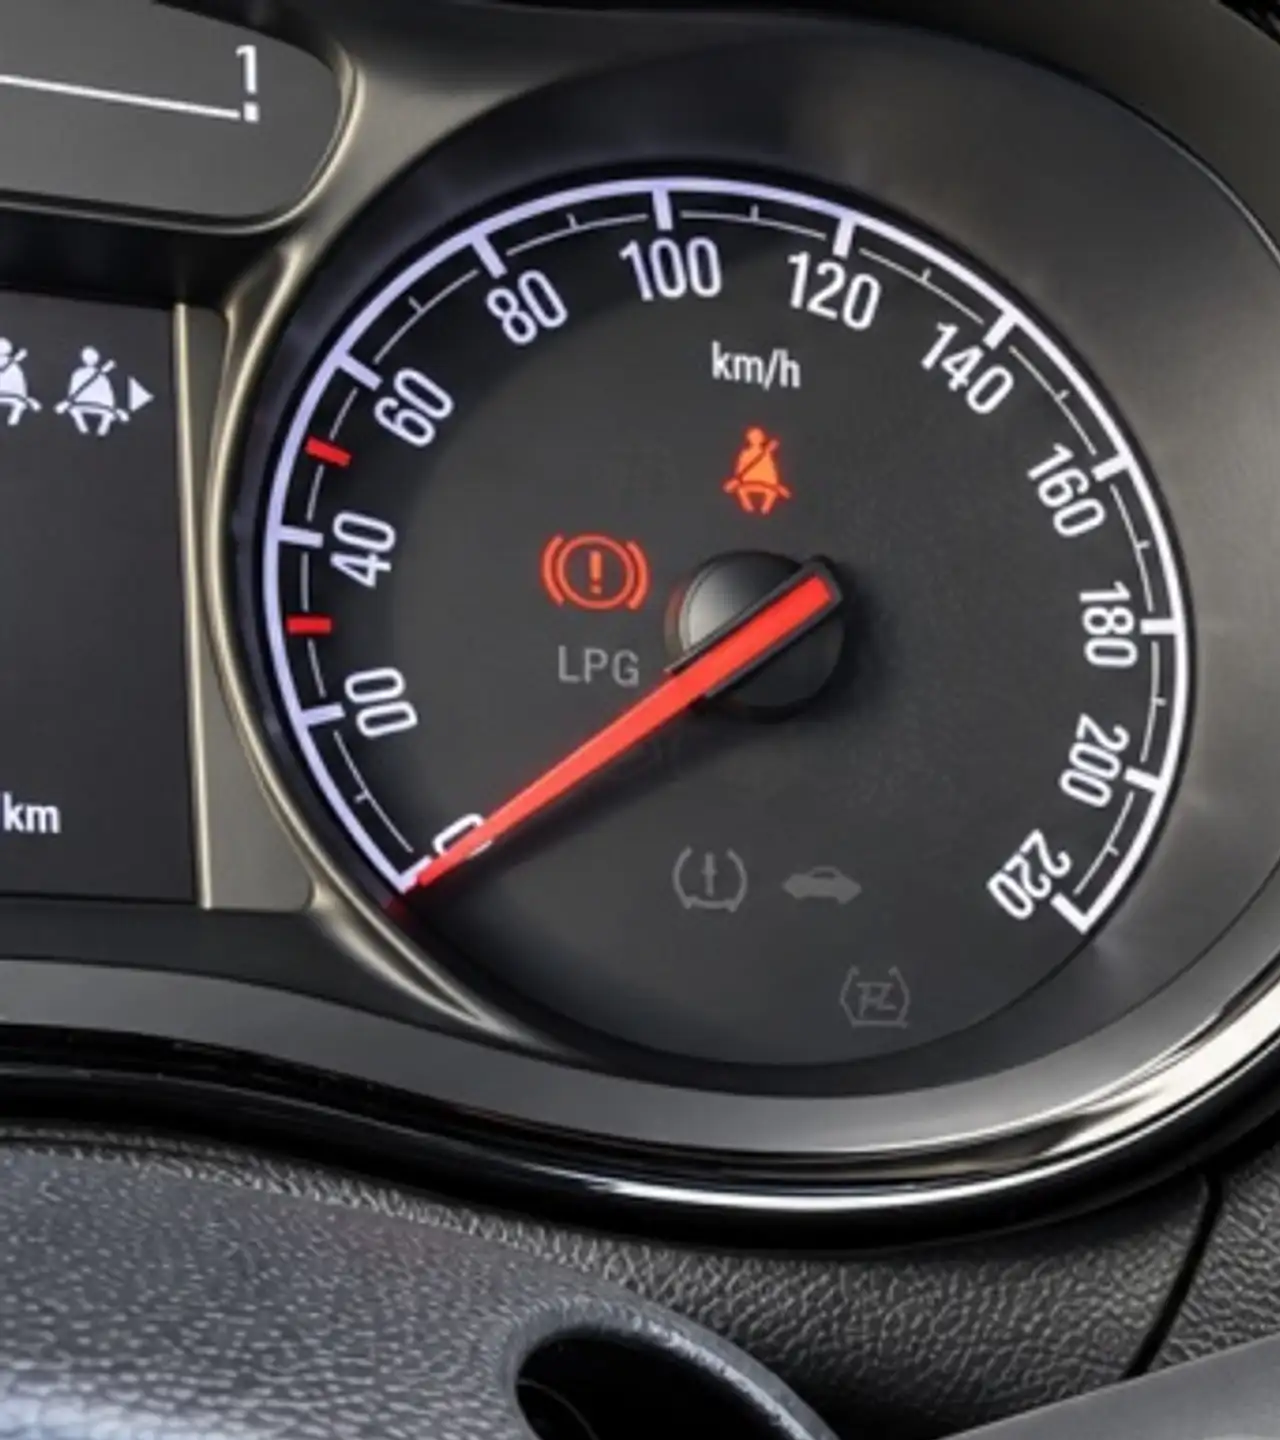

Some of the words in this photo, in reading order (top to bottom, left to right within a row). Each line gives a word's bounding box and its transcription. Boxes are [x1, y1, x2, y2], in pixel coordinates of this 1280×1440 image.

[486, 270, 568, 345] 80
[619, 237, 722, 301] 100
[787, 252, 881, 330] 120
[711, 341, 801, 390] km/h
[920, 322, 1014, 414] 140
[374, 368, 454, 448] 60
[1026, 443, 1106, 537] 160
[330, 512, 396, 588] 40
[1079, 581, 1138, 668] 180
[557, 645, 640, 686] LPG
[1059, 714, 1130, 807] 200
[3, 794, 61, 833] km
[986, 829, 1072, 920] 220
